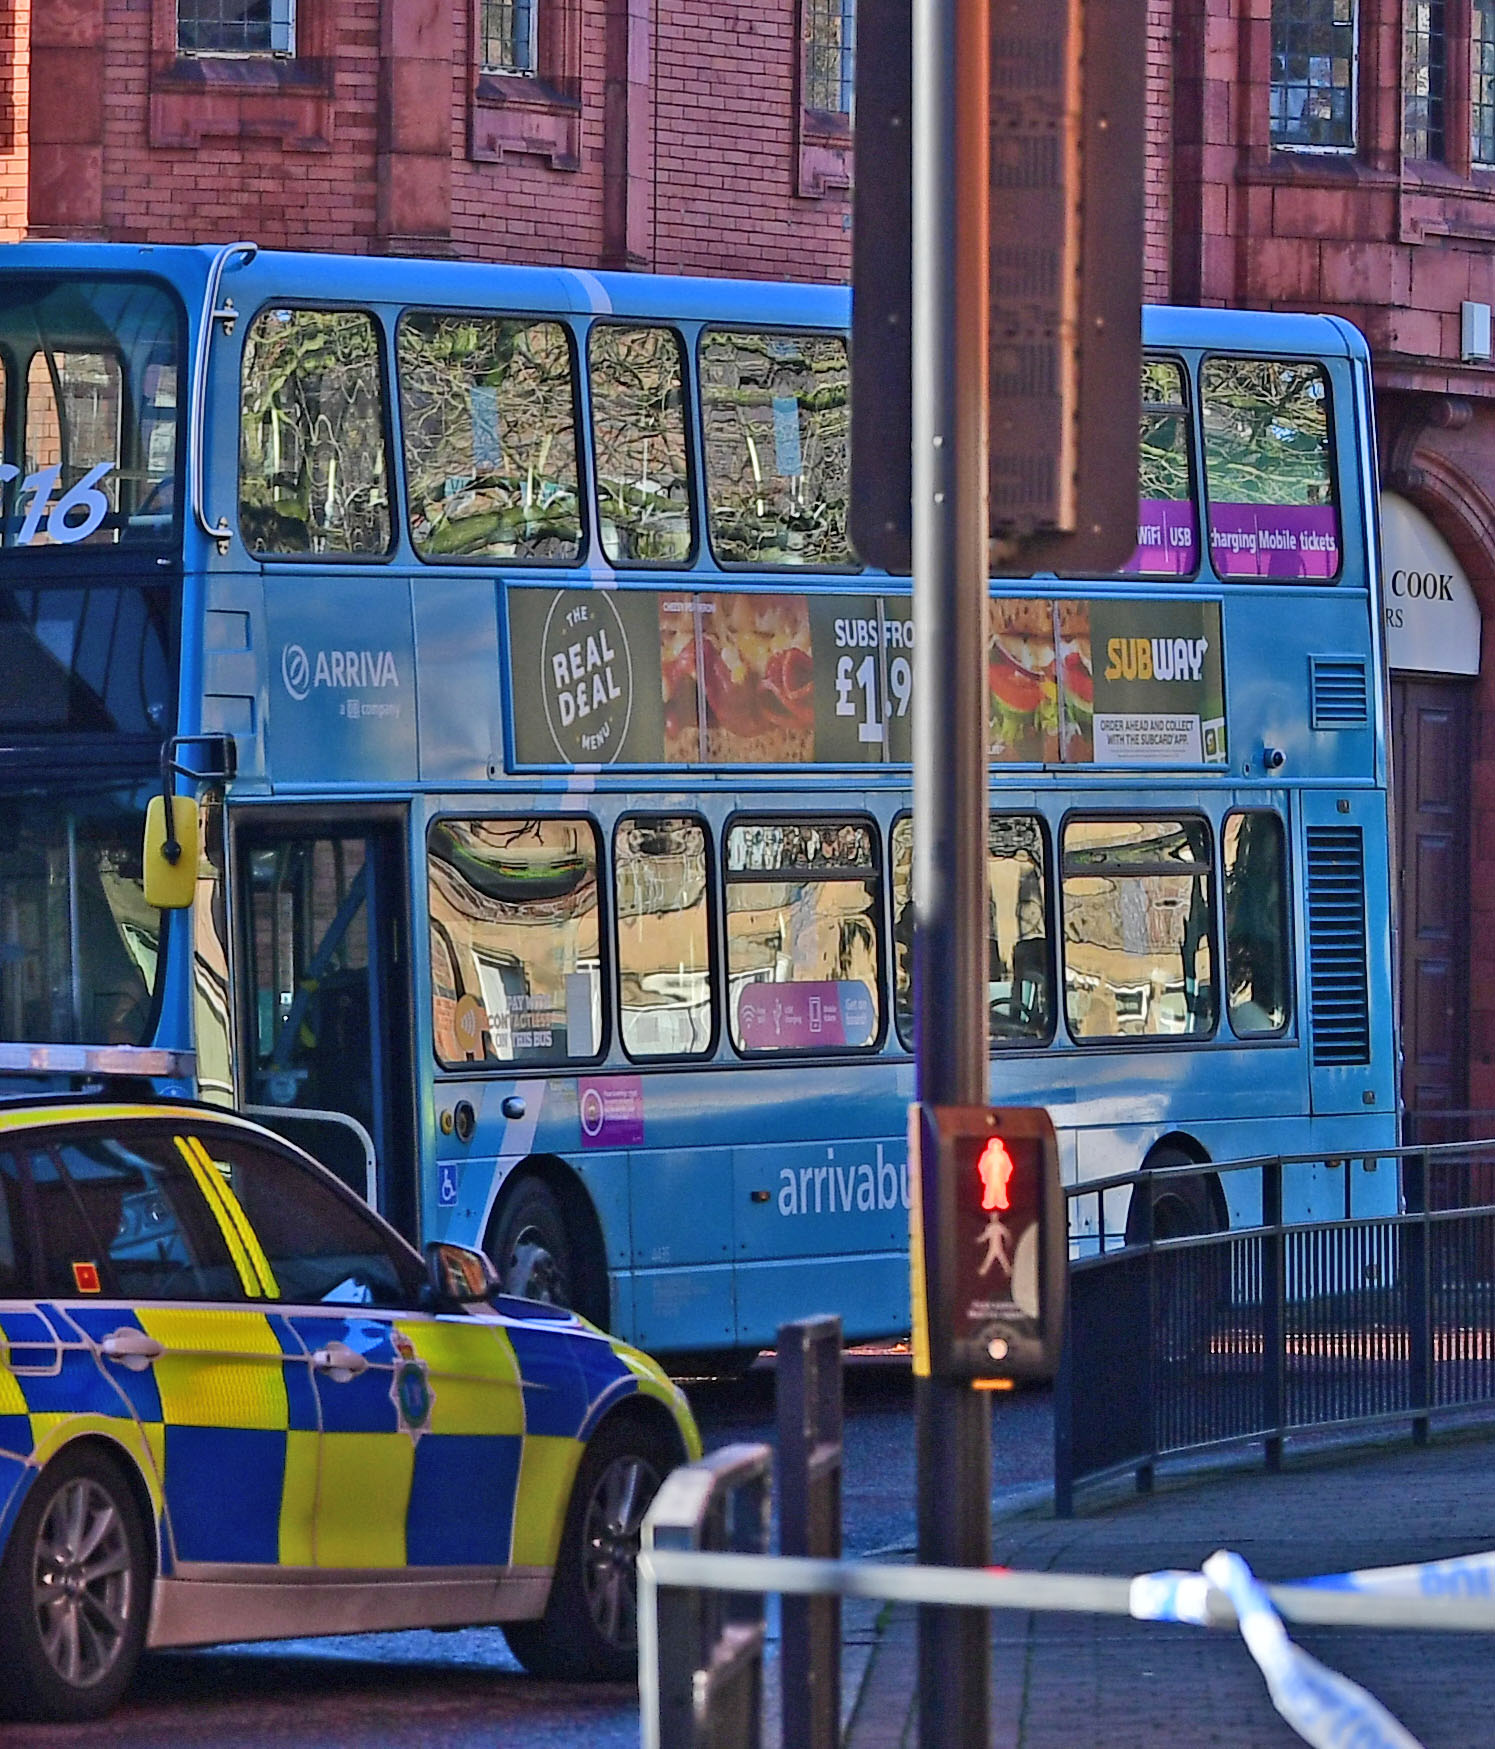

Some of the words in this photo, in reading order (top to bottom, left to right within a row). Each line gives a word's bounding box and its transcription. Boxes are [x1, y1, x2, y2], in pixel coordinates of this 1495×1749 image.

[1170, 527, 1191, 546] USB
[1259, 530, 1296, 550] Mobile
[1391, 569, 1454, 602] COOK
[566, 605, 588, 627] THE
[1385, 607, 1403, 629] RS
[834, 618, 878, 648] SUBS
[883, 620, 915, 648] FRO
[314, 651, 399, 688] ARRIVA
[552, 628, 615, 689] REAL
[1105, 636, 1208, 682] SUBWAY
[835, 655, 912, 742] £1.9
[582, 721, 611, 751] MENU
[1100, 719, 1123, 732] ORDER
[1125, 719, 1149, 732] AHEAD
[1150, 720, 1163, 731] AND
[1165, 720, 1194, 732] COLLECT
[1107, 733, 1124, 745] WITH
[1126, 733, 1139, 745] THE
[777, 1143, 911, 1217] arrivabu
